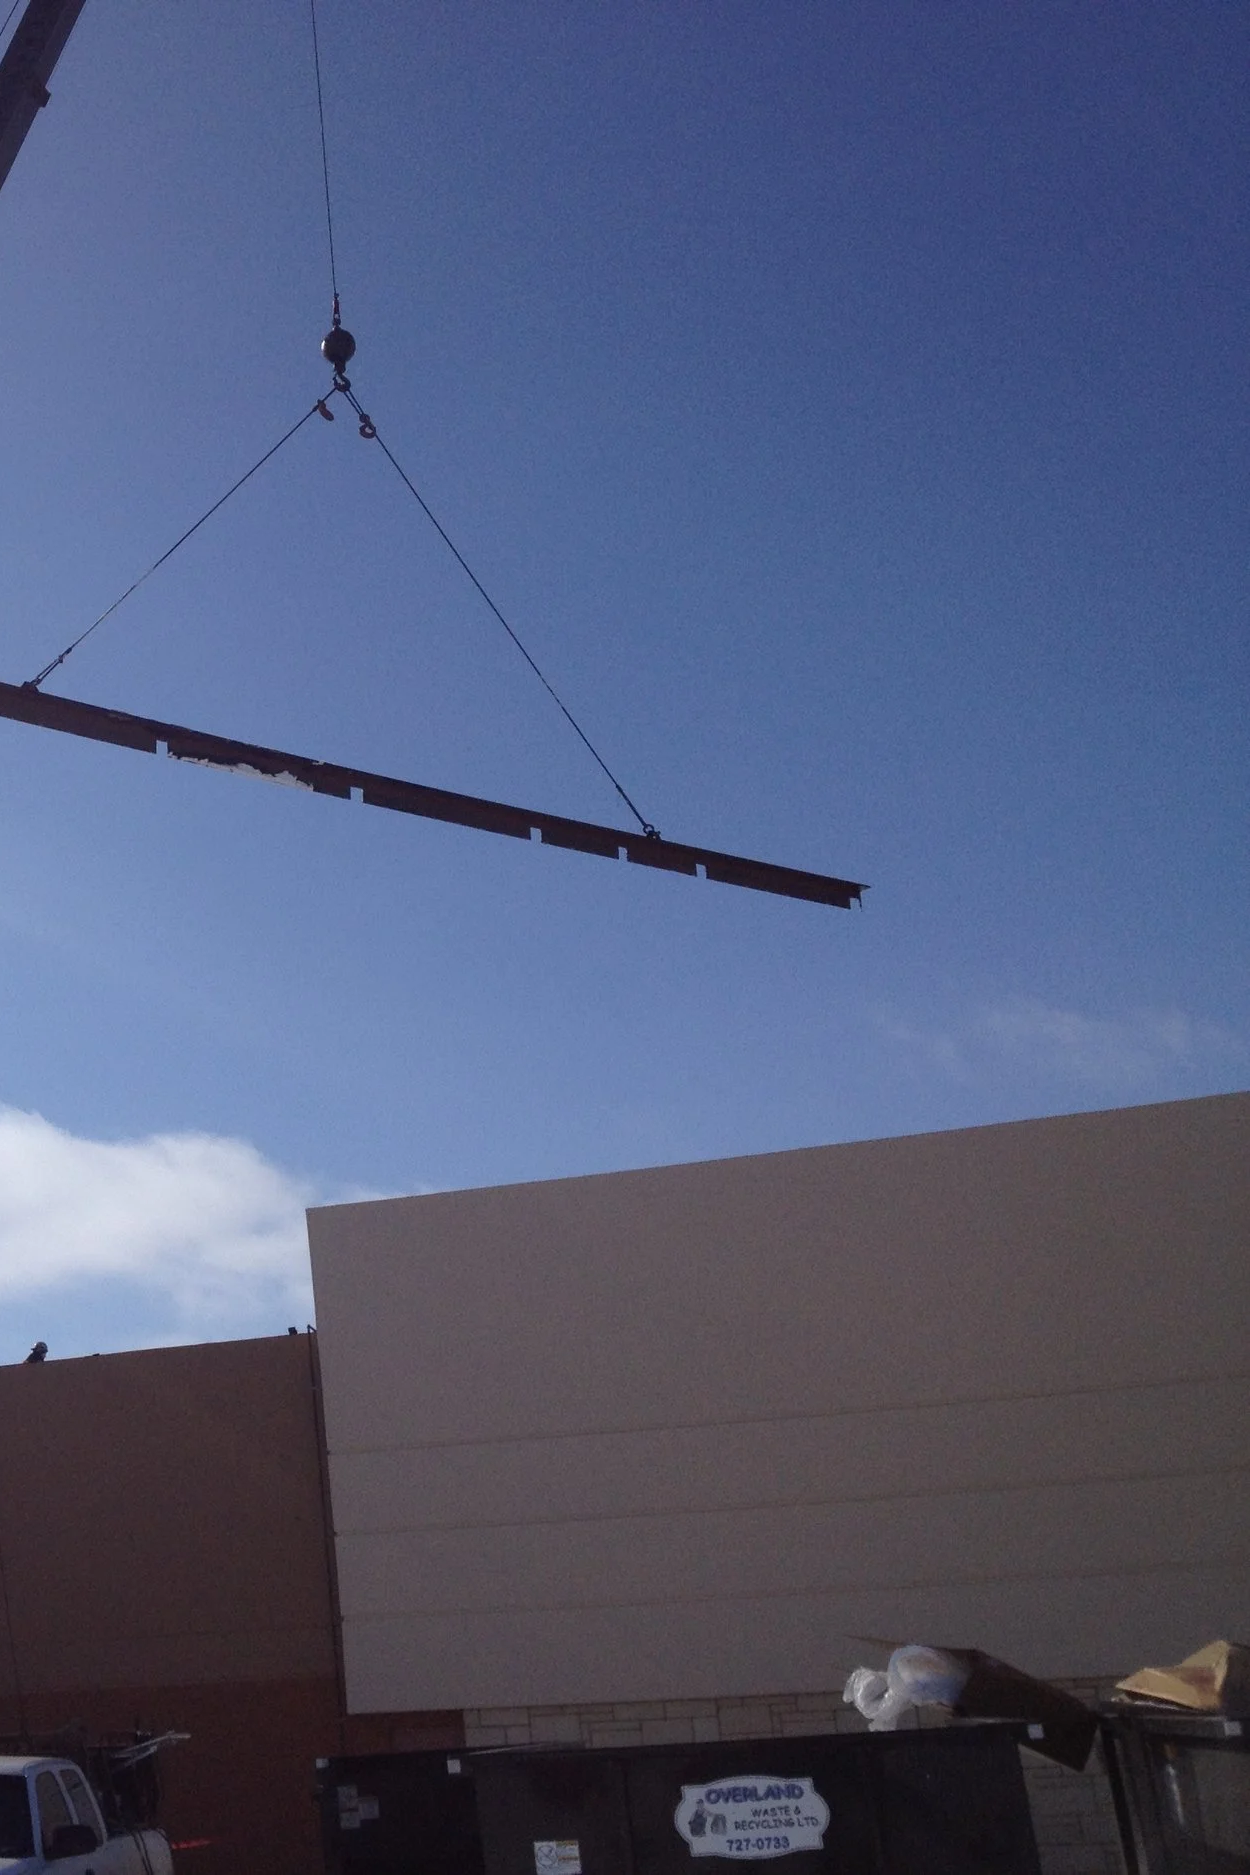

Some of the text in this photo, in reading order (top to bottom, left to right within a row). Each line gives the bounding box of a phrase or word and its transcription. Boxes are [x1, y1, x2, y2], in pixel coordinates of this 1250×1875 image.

[705, 1783, 804, 1804] OVERLAND
[751, 1805, 791, 1818] WASTE
[734, 1817, 795, 1831] RECYCLING
[726, 1835, 790, 1851] 727-0733
